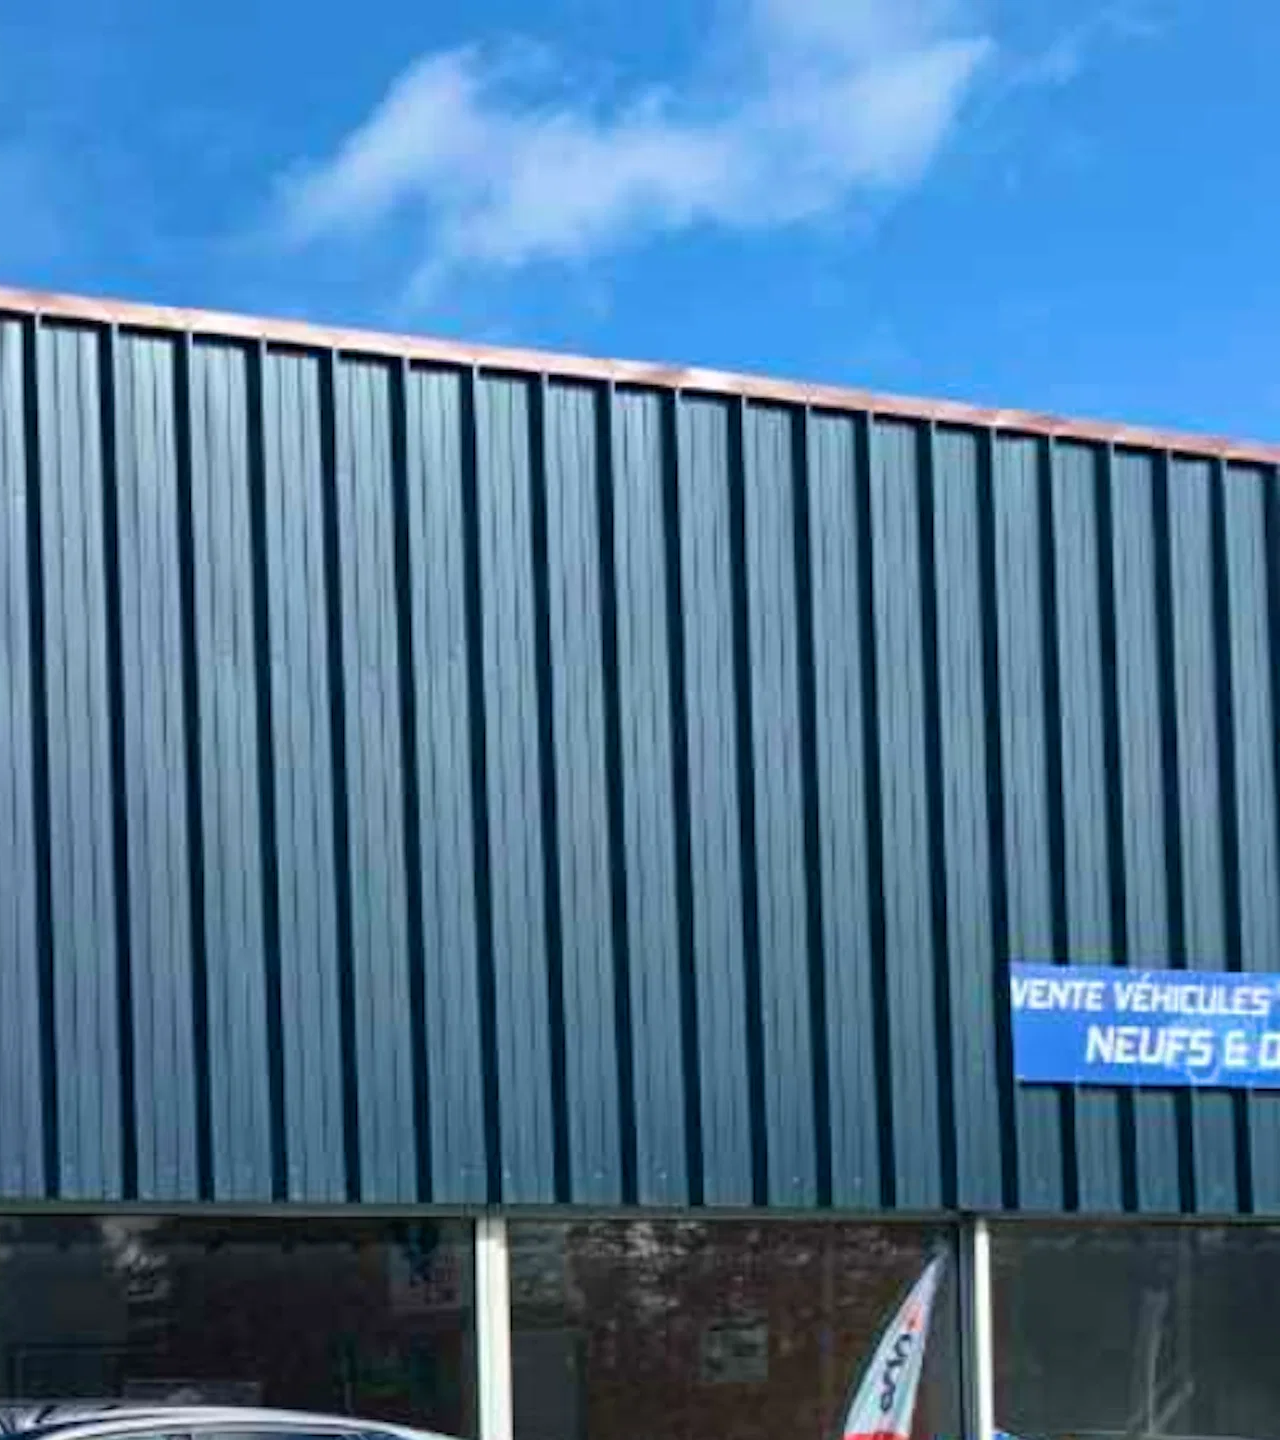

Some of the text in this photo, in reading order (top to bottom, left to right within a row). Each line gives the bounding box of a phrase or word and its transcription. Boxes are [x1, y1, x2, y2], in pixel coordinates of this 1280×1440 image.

[1011, 973, 1271, 1016] VENTE VÉHICULES
[1085, 1025, 1215, 1067] NEUFS
